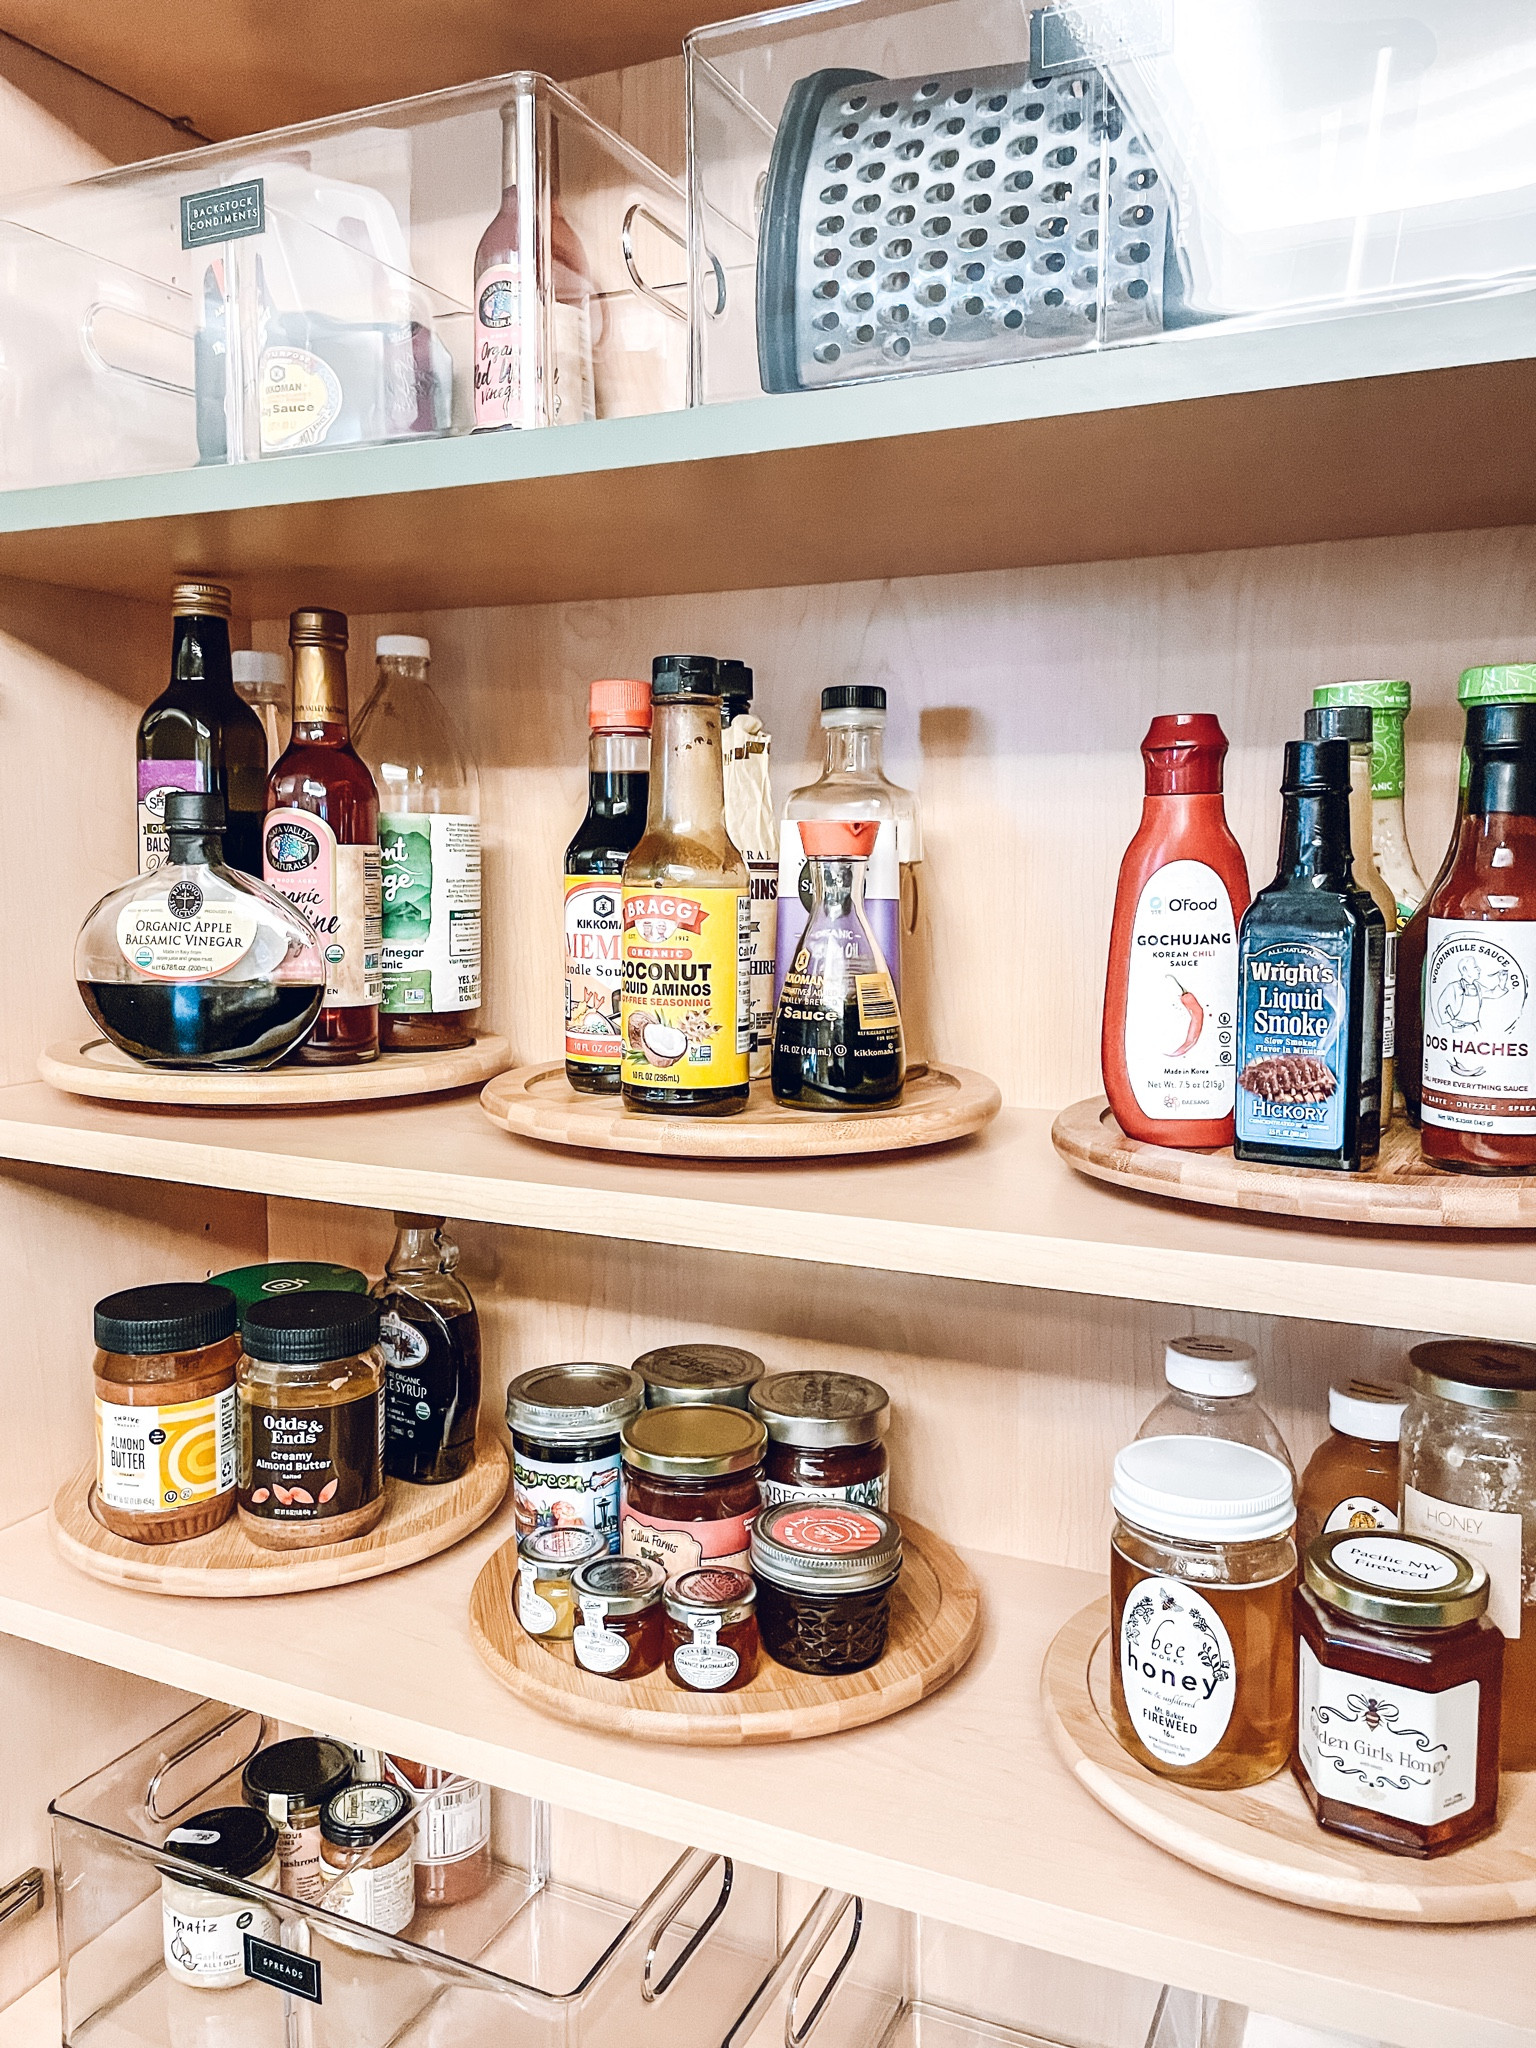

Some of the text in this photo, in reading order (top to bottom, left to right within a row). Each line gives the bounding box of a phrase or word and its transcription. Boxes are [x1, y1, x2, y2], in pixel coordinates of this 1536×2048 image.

[193, 196, 253, 218] BACKSTOCK
[190, 208, 258, 231] CONDIMENTS
[272, 404, 315, 414] Sauce
[1371, 781, 1393, 791] ANIC
[267, 825, 312, 840] NAPA VALLEY
[742, 850, 771, 861] RAL
[270, 858, 308, 871] NATURALS
[381, 873, 415, 902] ge
[627, 898, 693, 919] BRAGG
[135, 920, 232, 934] ORGANIC APPLE
[125, 934, 244, 948] BALSAMIC VINEGAR
[1137, 932, 1231, 946] GOCHUJANG
[631, 947, 684, 959] ORGANIC
[845, 942, 859, 959] Oil
[1432, 943, 1477, 984] WOODINVILLE
[1478, 945, 1510, 968] SAUCE
[1250, 960, 1334, 987] Wright's
[652, 983, 712, 997] AMINOS
[650, 997, 711, 1007] SEASONING
[1259, 987, 1324, 1014] Liquid
[783, 1006, 839, 1021] Sauce
[1254, 1009, 1328, 1037] Smoke
[581, 1043, 590, 1052] FL
[592, 1043, 602, 1053] OZ
[1255, 1044, 1281, 1053] Flavor
[1264, 1037, 1317, 1047] Slow Smoked
[1425, 1033, 1529, 1057] DOS HACHES
[791, 1046, 800, 1054] OZ
[1147, 1080, 1162, 1089] Net
[1179, 1080, 1191, 1089] 7.5
[1431, 1077, 1452, 1086] PEPPER
[1452, 1081, 1502, 1092] EVERYTHING
[1252, 1100, 1328, 1123] HICKORY
[1456, 1101, 1497, 1111] DRIZZLE
[395, 1371, 421, 1386] ORGANIC
[395, 1380, 428, 1399] SYRUP
[113, 1416, 140, 1424] THRIVE
[263, 1415, 324, 1434] Odds &
[110, 1435, 145, 1450] ALMOND
[271, 1430, 317, 1445] Ends
[111, 1450, 146, 1470] BUTTER
[271, 1451, 313, 1462] Creamy
[256, 1459, 332, 1471] Almond Butter
[1427, 1507, 1483, 1535] HONEY
[651, 1534, 679, 1554] Farms
[1350, 1547, 1443, 1572] Pacific NW
[1354, 1558, 1430, 1580] Fireweed
[1151, 1619, 1186, 1659] bee
[1151, 1652, 1185, 1666] WORKS
[1128, 1641, 1219, 1701] honey
[1143, 1707, 1198, 1735] FIREWEED
[1165, 1709, 1185, 1721] Baker
[1354, 1739, 1451, 1777] Girls Honey
[172, 1916, 218, 1934] matiz
[262, 1957, 304, 1980] SPREADS
